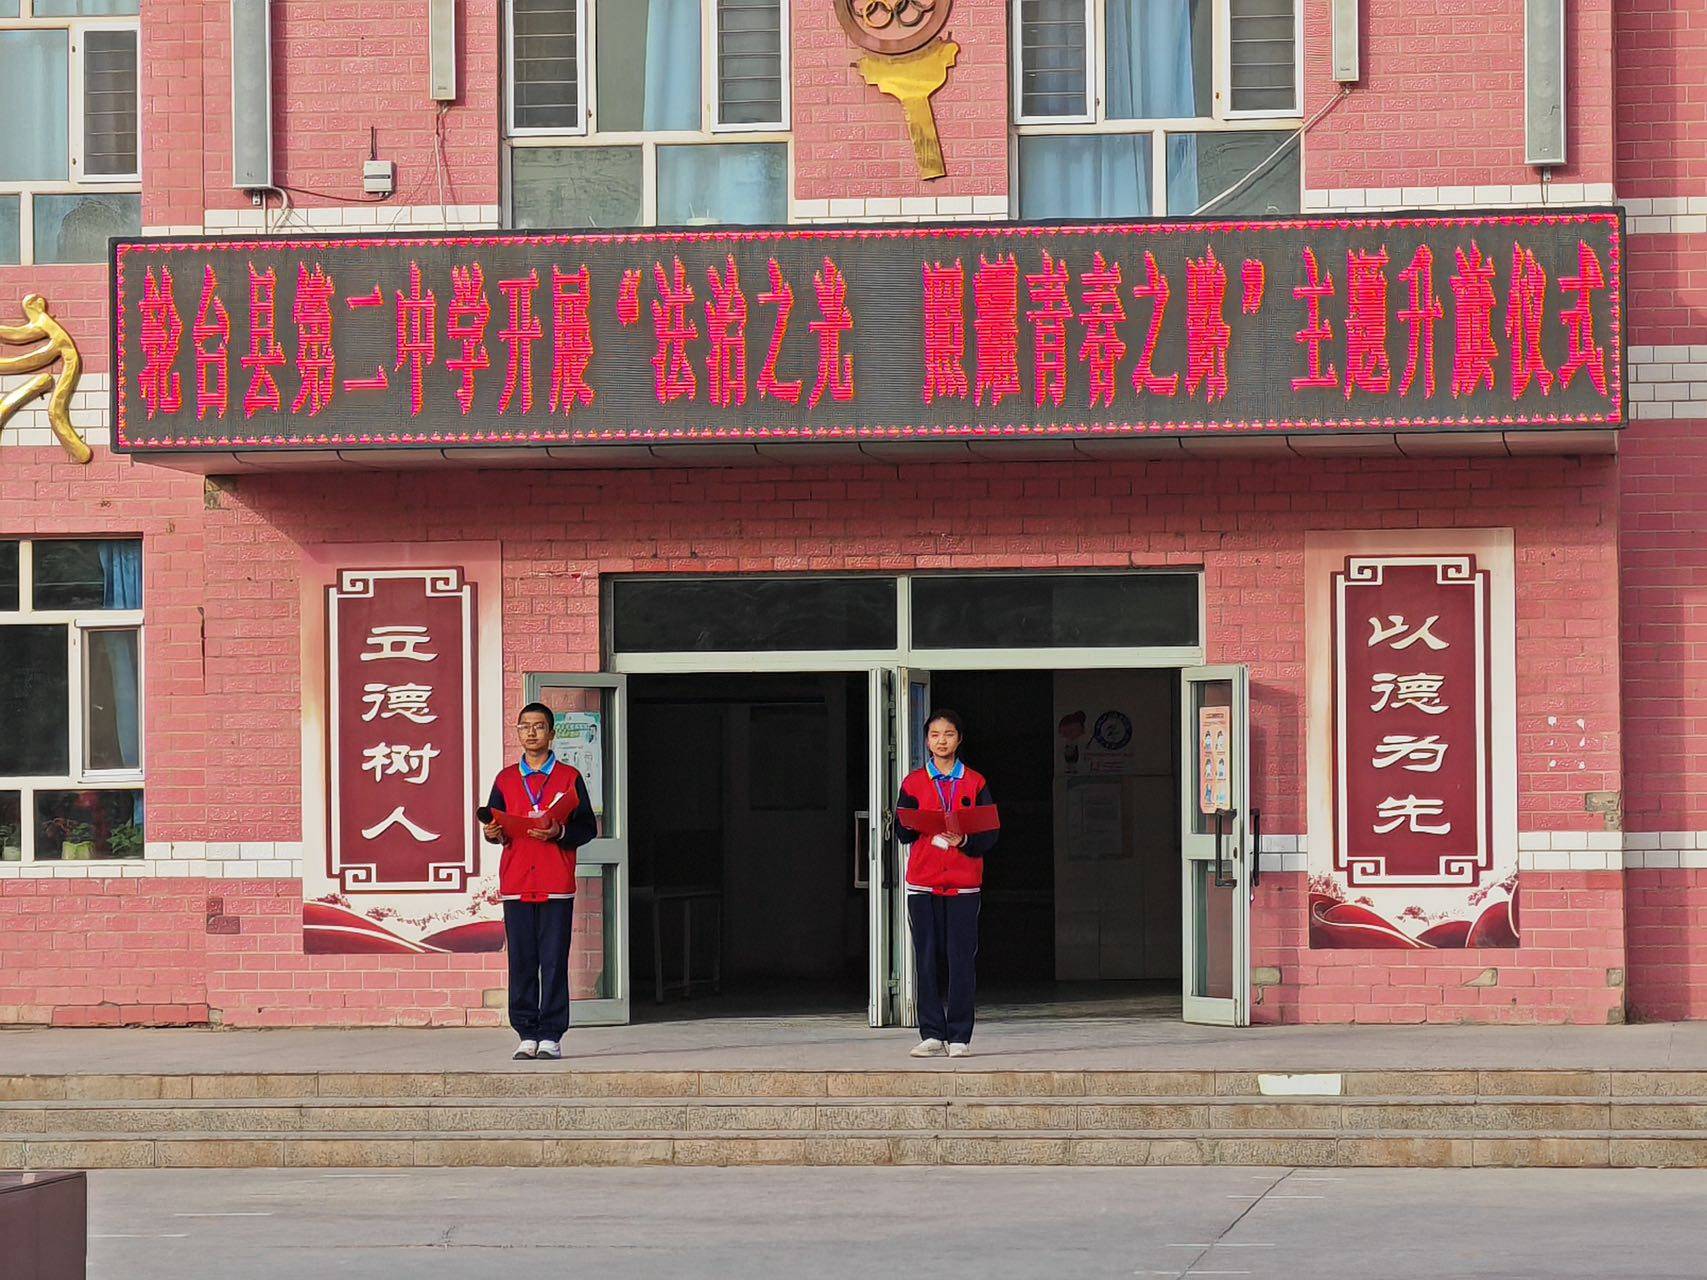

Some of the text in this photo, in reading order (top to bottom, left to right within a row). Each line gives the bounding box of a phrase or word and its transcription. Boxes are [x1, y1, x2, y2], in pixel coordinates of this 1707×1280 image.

[360, 625, 441, 843] 立德树人
[1367, 614, 1451, 835] 以德为先
